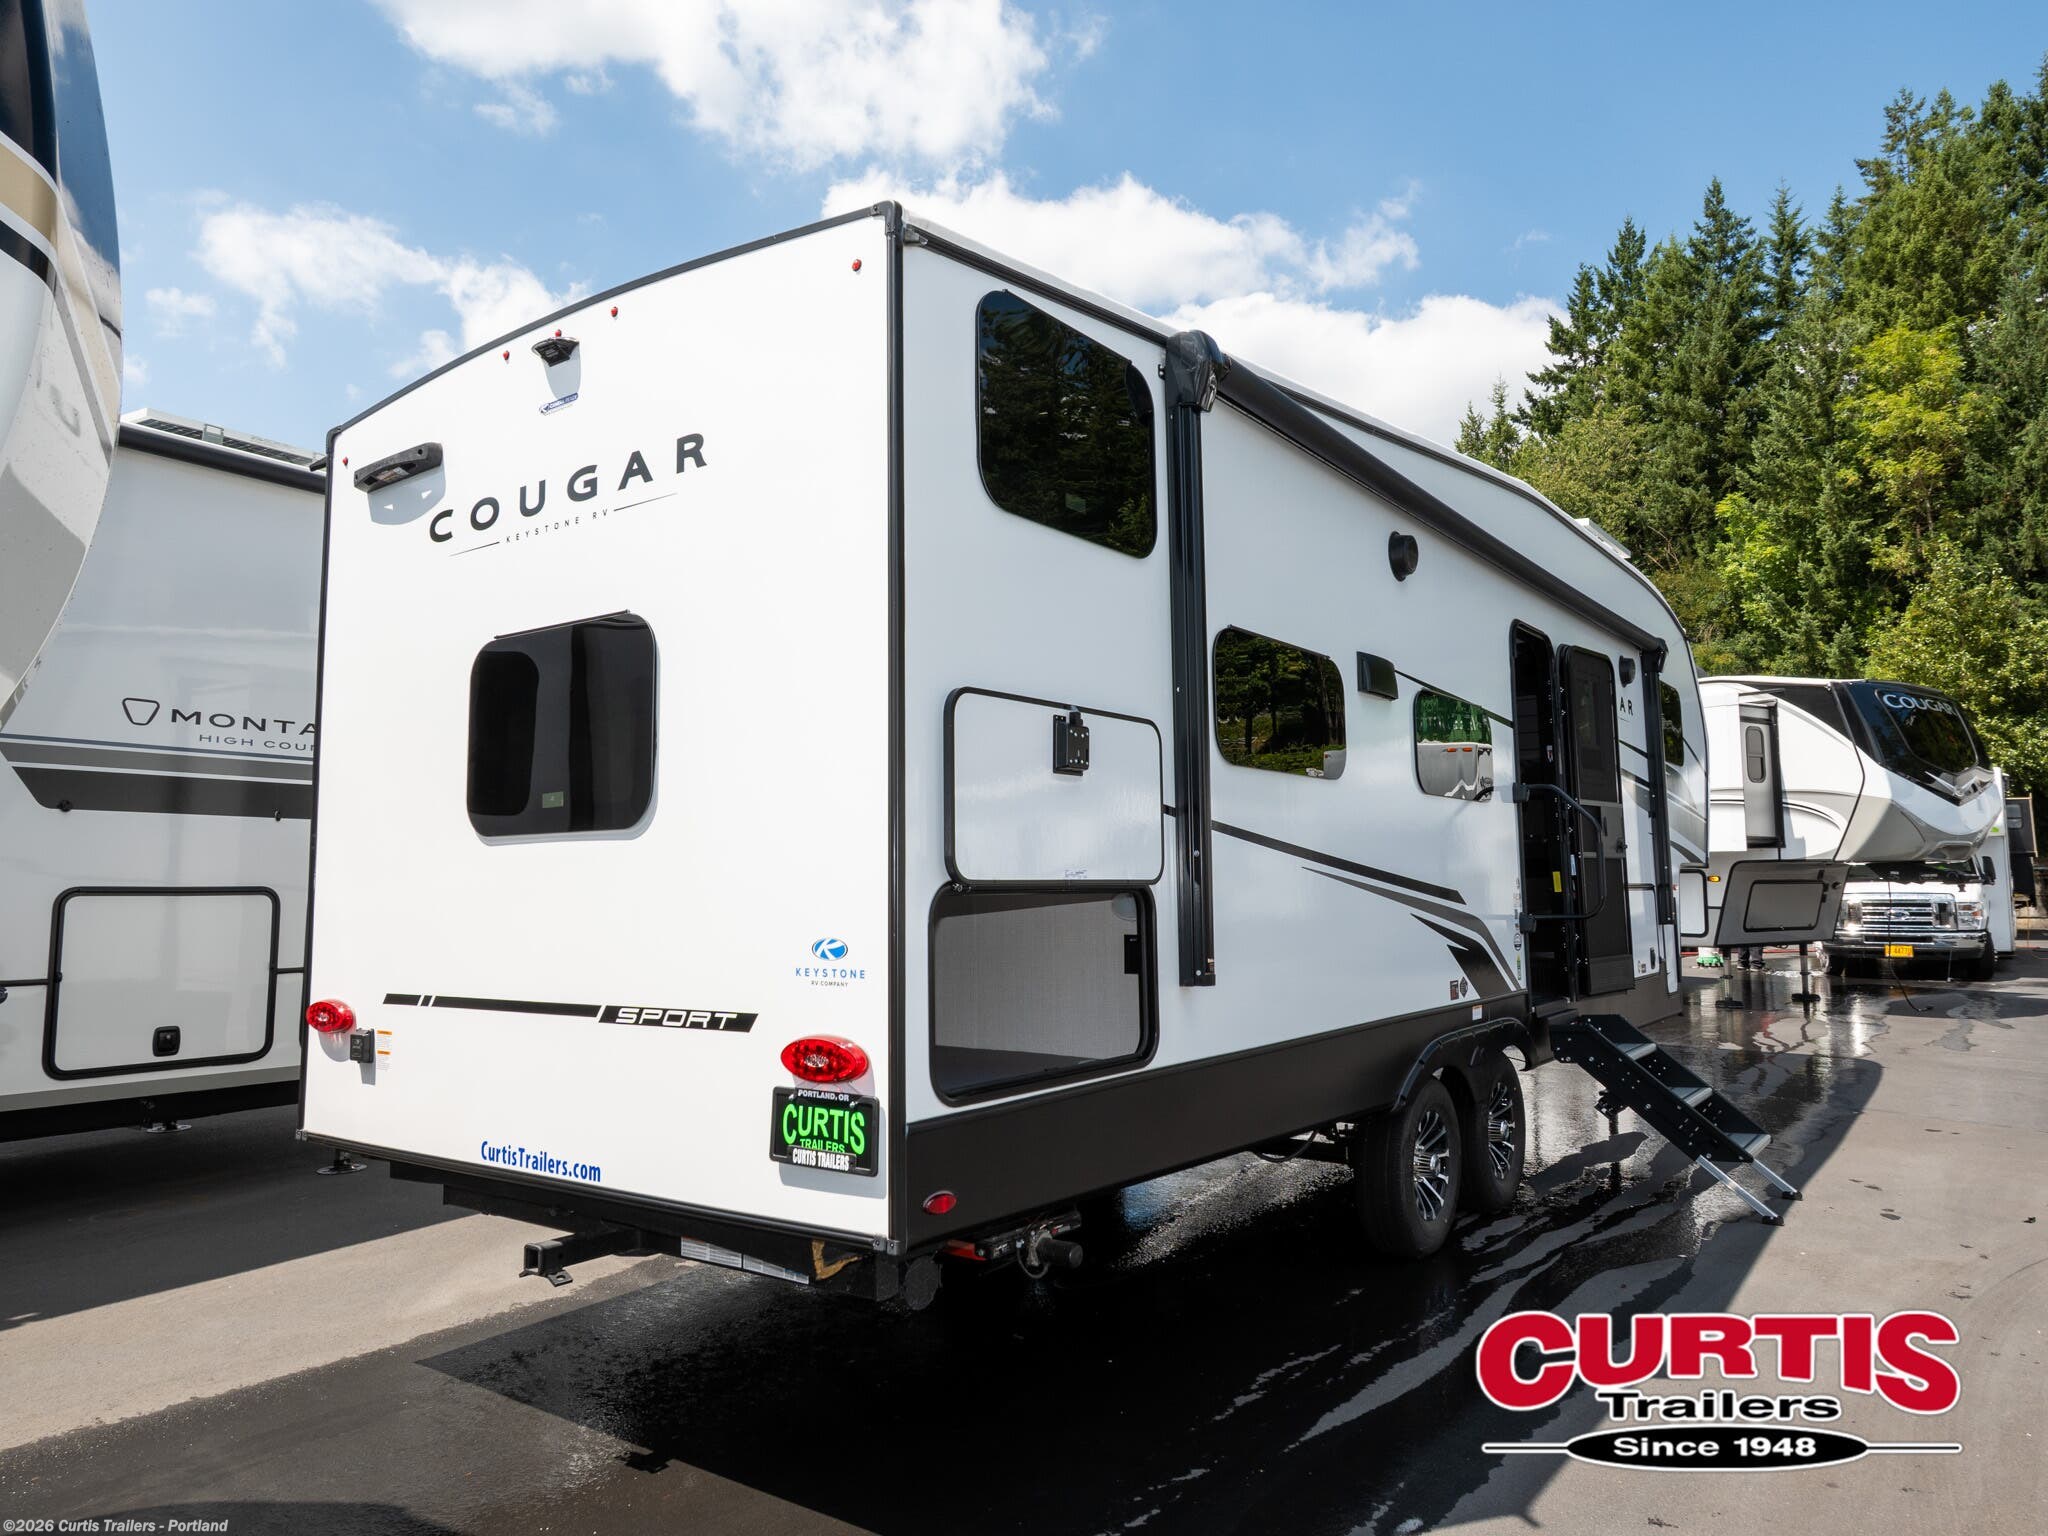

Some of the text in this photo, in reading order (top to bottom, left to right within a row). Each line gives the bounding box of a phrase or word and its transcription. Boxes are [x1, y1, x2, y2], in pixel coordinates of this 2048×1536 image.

[429, 433, 708, 543] COUGAR
[505, 508, 609, 543] KEYSTONE RV
[1882, 694, 1957, 717] COUGAR
[199, 734, 254, 747] HIGH
[795, 967, 865, 979] KEYSTONE
[615, 1007, 738, 1030] SPORT
[797, 1089, 850, 1102] PORTLAND, OR
[782, 1103, 865, 1155] CURTIS
[481, 1140, 601, 1183] CurtisTrailers.com
[792, 1147, 850, 1172] CURTIS TRAILERS
